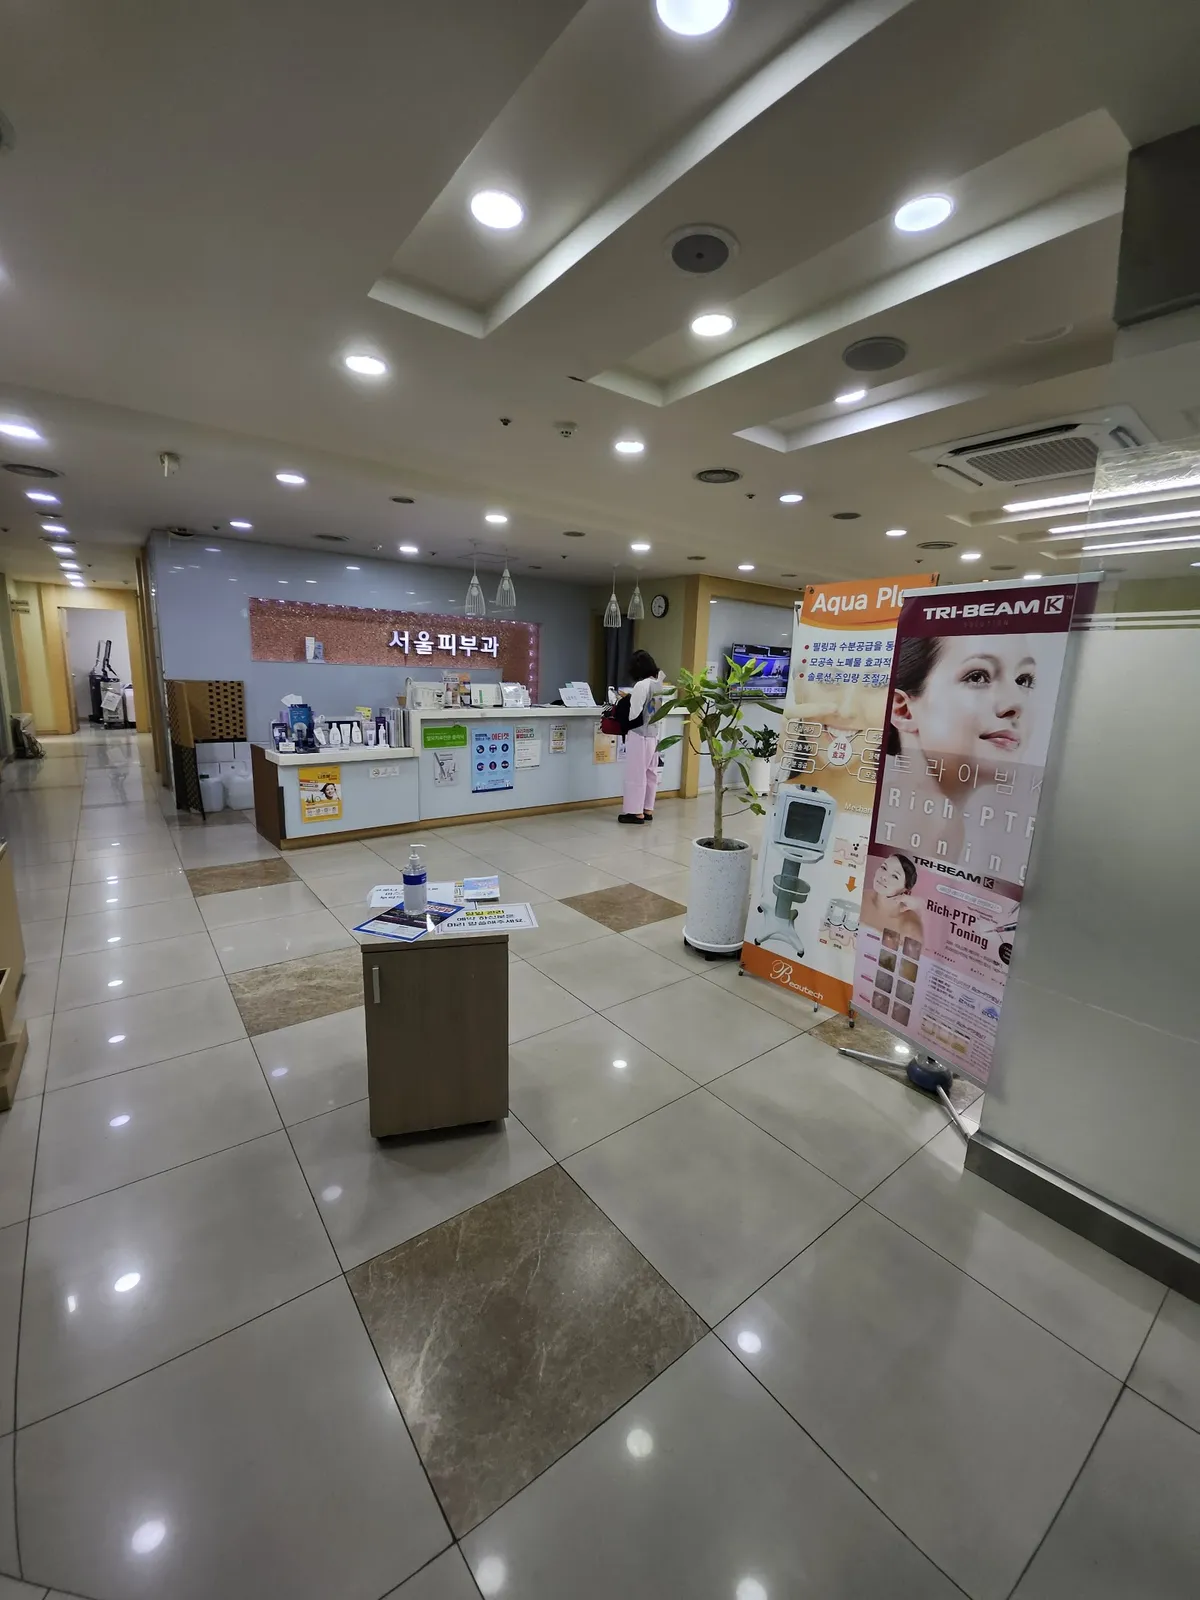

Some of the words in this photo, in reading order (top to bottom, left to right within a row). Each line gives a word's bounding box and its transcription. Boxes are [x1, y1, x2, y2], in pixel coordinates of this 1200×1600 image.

[811, 589, 869, 616] Aqua
[923, 599, 1040, 620] TRI-BEAM
[1044, 595, 1065, 615] K
[389, 630, 500, 659] 서울피부과
[813, 642, 837, 652] 필링과
[839, 640, 883, 652] 수분공급을
[809, 657, 834, 667] 모공속
[836, 657, 862, 667] 노폐물
[807, 672, 832, 682] 솔루션
[834, 673, 860, 684] 주입량
[491, 732, 510, 741] 에티켓
[833, 742, 847, 750] 기대
[832, 751, 846, 760] 효과
[889, 754, 1017, 796] 트라이빔
[912, 855, 982, 885] TRI-BEAM
[926, 899, 976, 926] Rich-PTP
[950, 921, 989, 950] Toning
[769, 959, 824, 1001] Beautech
